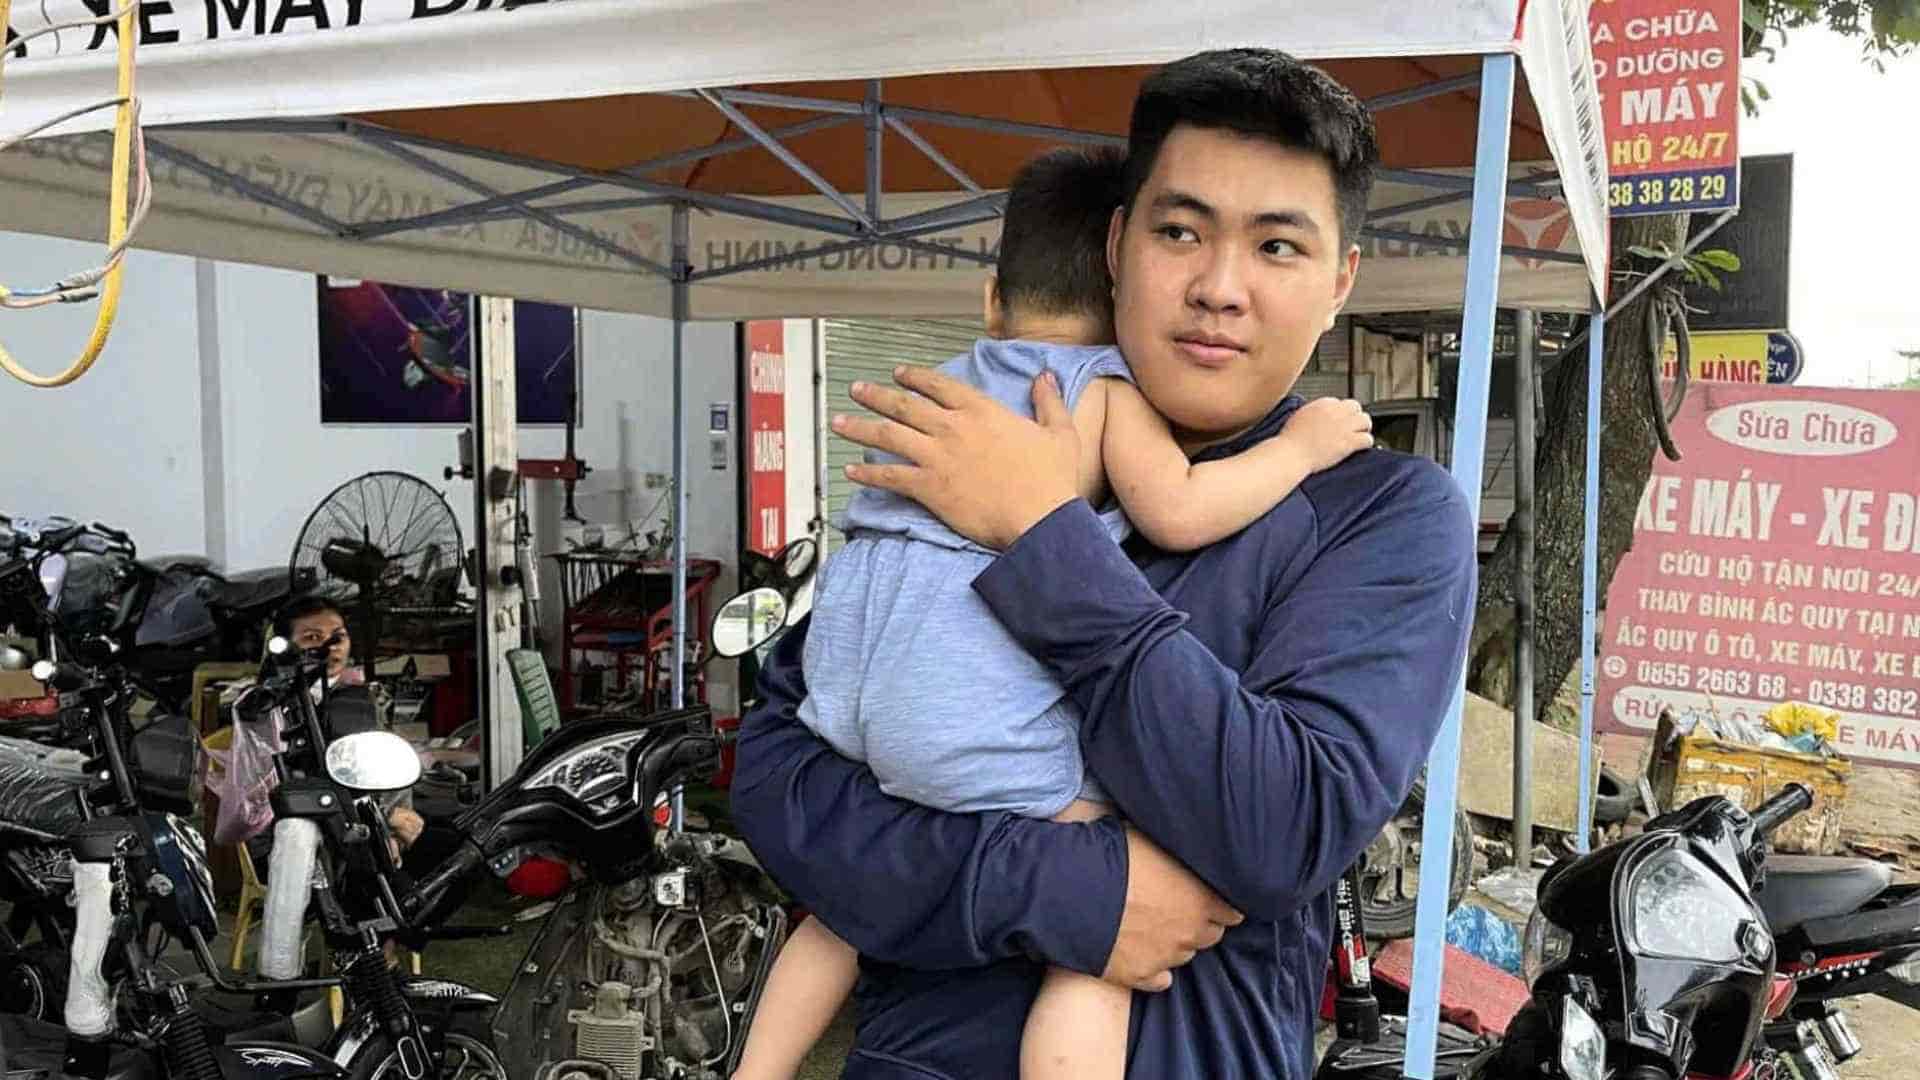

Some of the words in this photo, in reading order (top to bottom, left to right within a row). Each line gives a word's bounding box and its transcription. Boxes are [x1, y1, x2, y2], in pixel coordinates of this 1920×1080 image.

[1624, 9, 1720, 41] CHỮA
[1617, 48, 1724, 78] DƯỠNG
[1621, 78, 1724, 125] MÁY
[1612, 133, 1652, 169] HỘ
[1662, 131, 1729, 163] 24/7
[1639, 179, 1664, 205] 38
[1669, 177, 1695, 202] 28
[1700, 174, 1726, 200] 29
[1737, 409, 1789, 440] Sửa
[1689, 468, 1782, 541] MÁY
[1817, 487, 1875, 550] XE
[1659, 549, 1711, 577] CỨU
[1717, 554, 1753, 586] HỘ
[1761, 558, 1815, 592] TẬN
[1822, 565, 1871, 593] NƠI
[1638, 587, 1691, 614] THAY
[1698, 591, 1756, 622] BÌNH
[1801, 604, 1850, 631] QUY
[1855, 608, 1896, 640] TẠI
[1653, 627, 1698, 653] QUY
[1704, 628, 1720, 656] Ô
[1769, 640, 1800, 665] XE
[1872, 651, 1905, 677] XE
[1637, 660, 1692, 688] 0855
[1696, 666, 1752, 696] 2663
[1757, 673, 1787, 700] 68
[1808, 679, 1867, 709] 0338
[1872, 686, 1919, 716] 382
